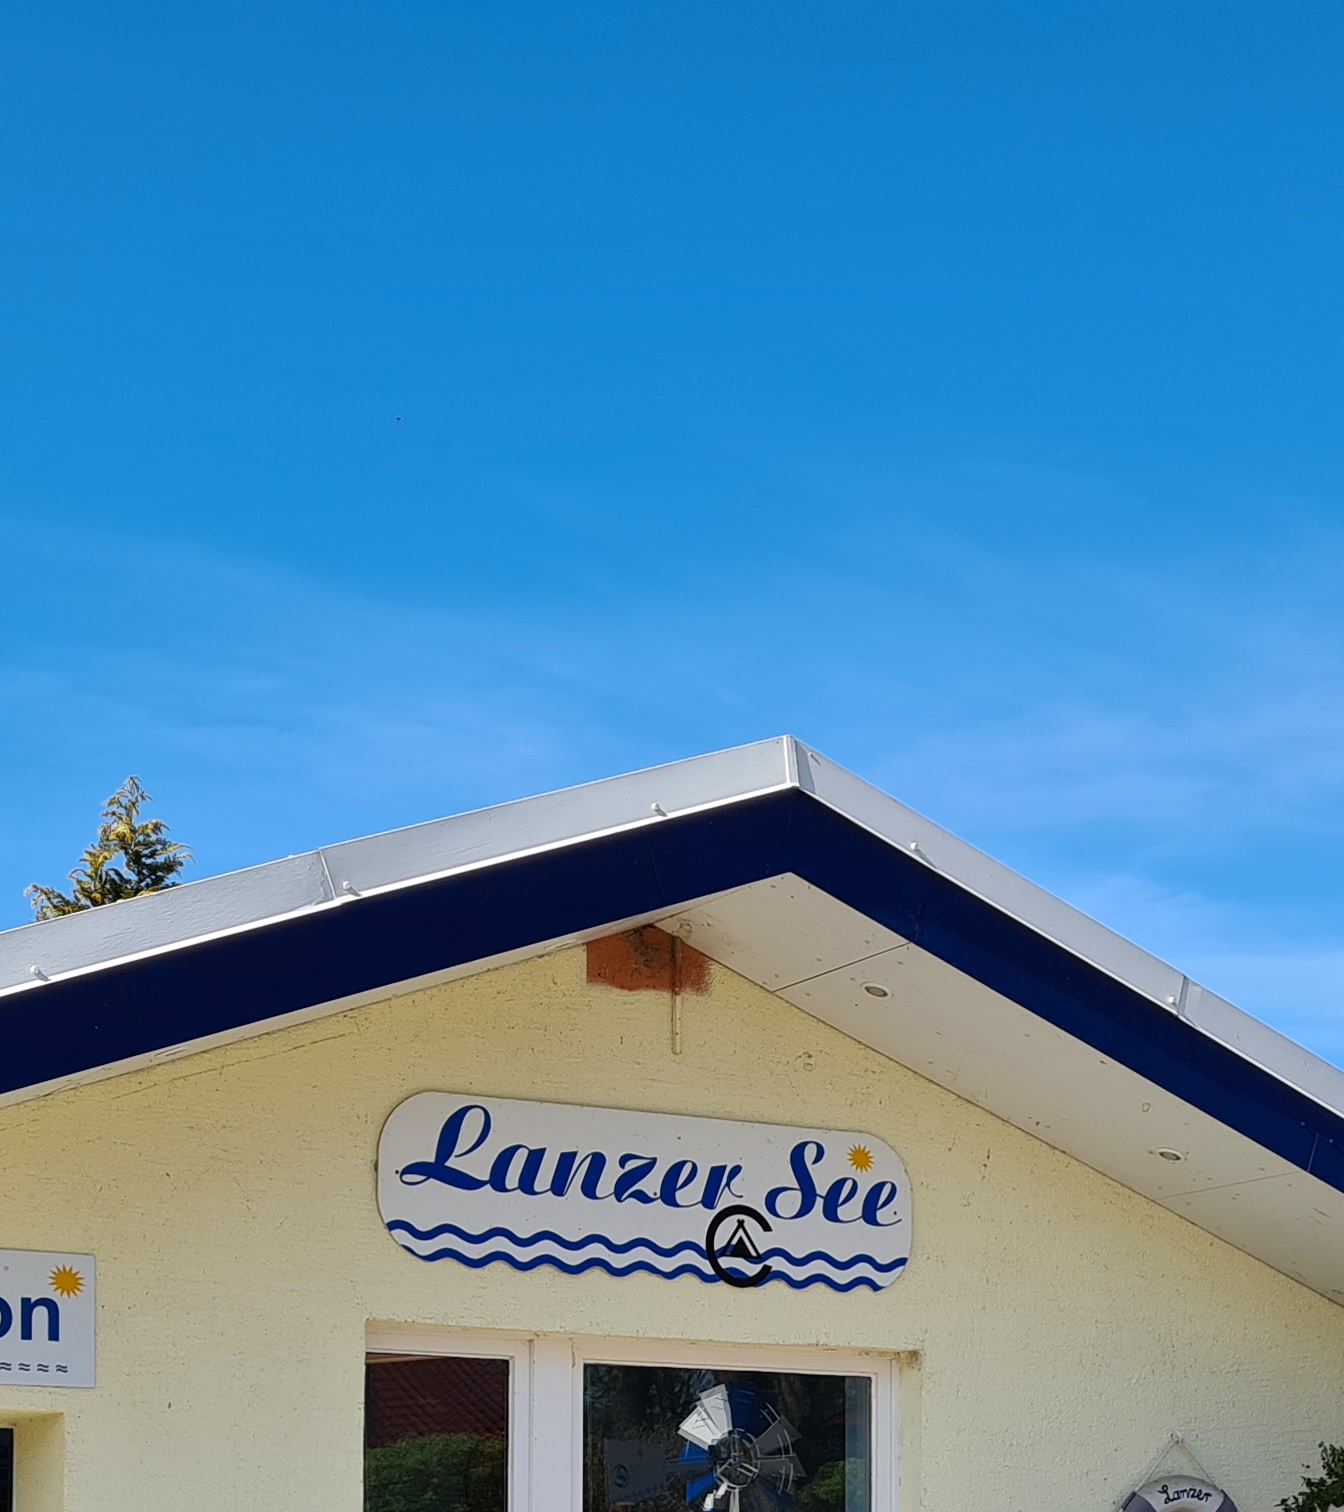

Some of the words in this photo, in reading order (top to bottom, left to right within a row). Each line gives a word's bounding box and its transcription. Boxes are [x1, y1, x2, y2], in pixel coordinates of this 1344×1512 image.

[399, 1105, 743, 1211] Lanzer
[765, 1140, 902, 1227] See
[1157, 1484, 1213, 1505] Lanzer
